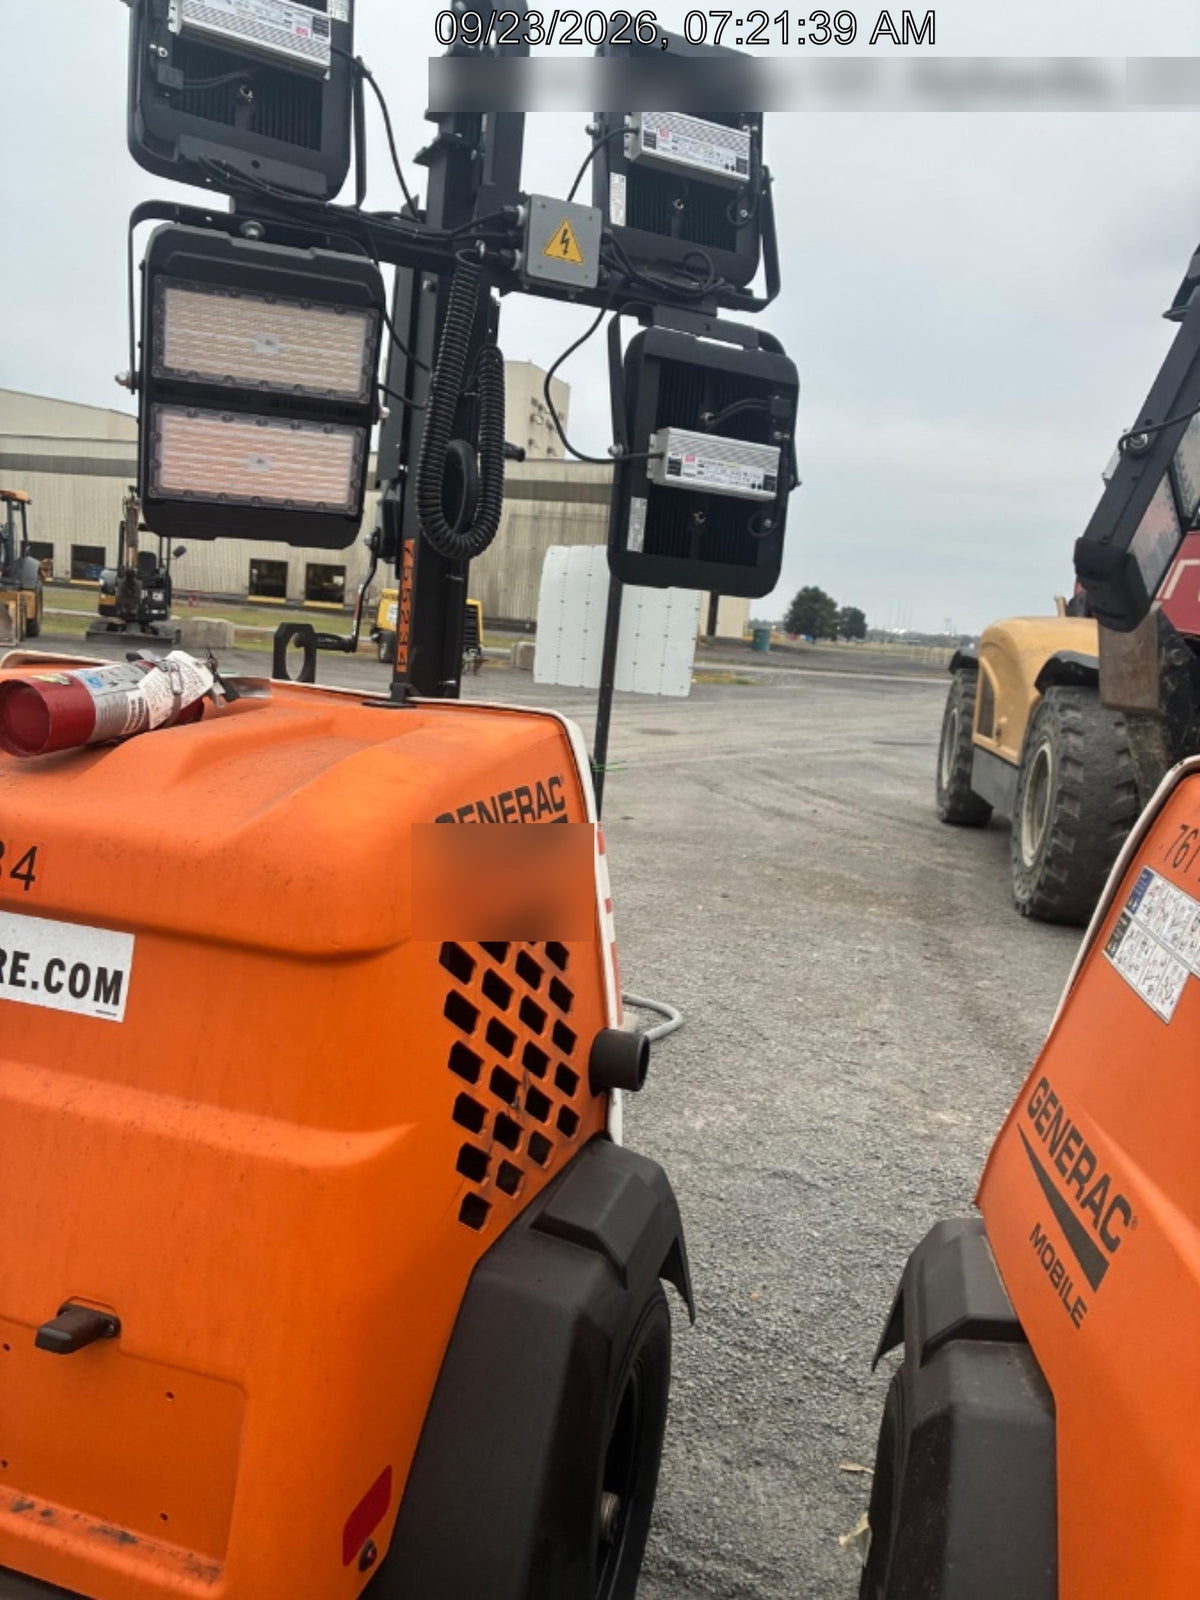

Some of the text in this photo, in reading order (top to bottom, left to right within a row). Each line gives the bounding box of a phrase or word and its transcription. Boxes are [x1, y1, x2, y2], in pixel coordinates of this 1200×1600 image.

[0, 839, 38, 891] 4
[1027, 1076, 1132, 1253] GENERAC
[1029, 1222, 1087, 1329] MOBILE
